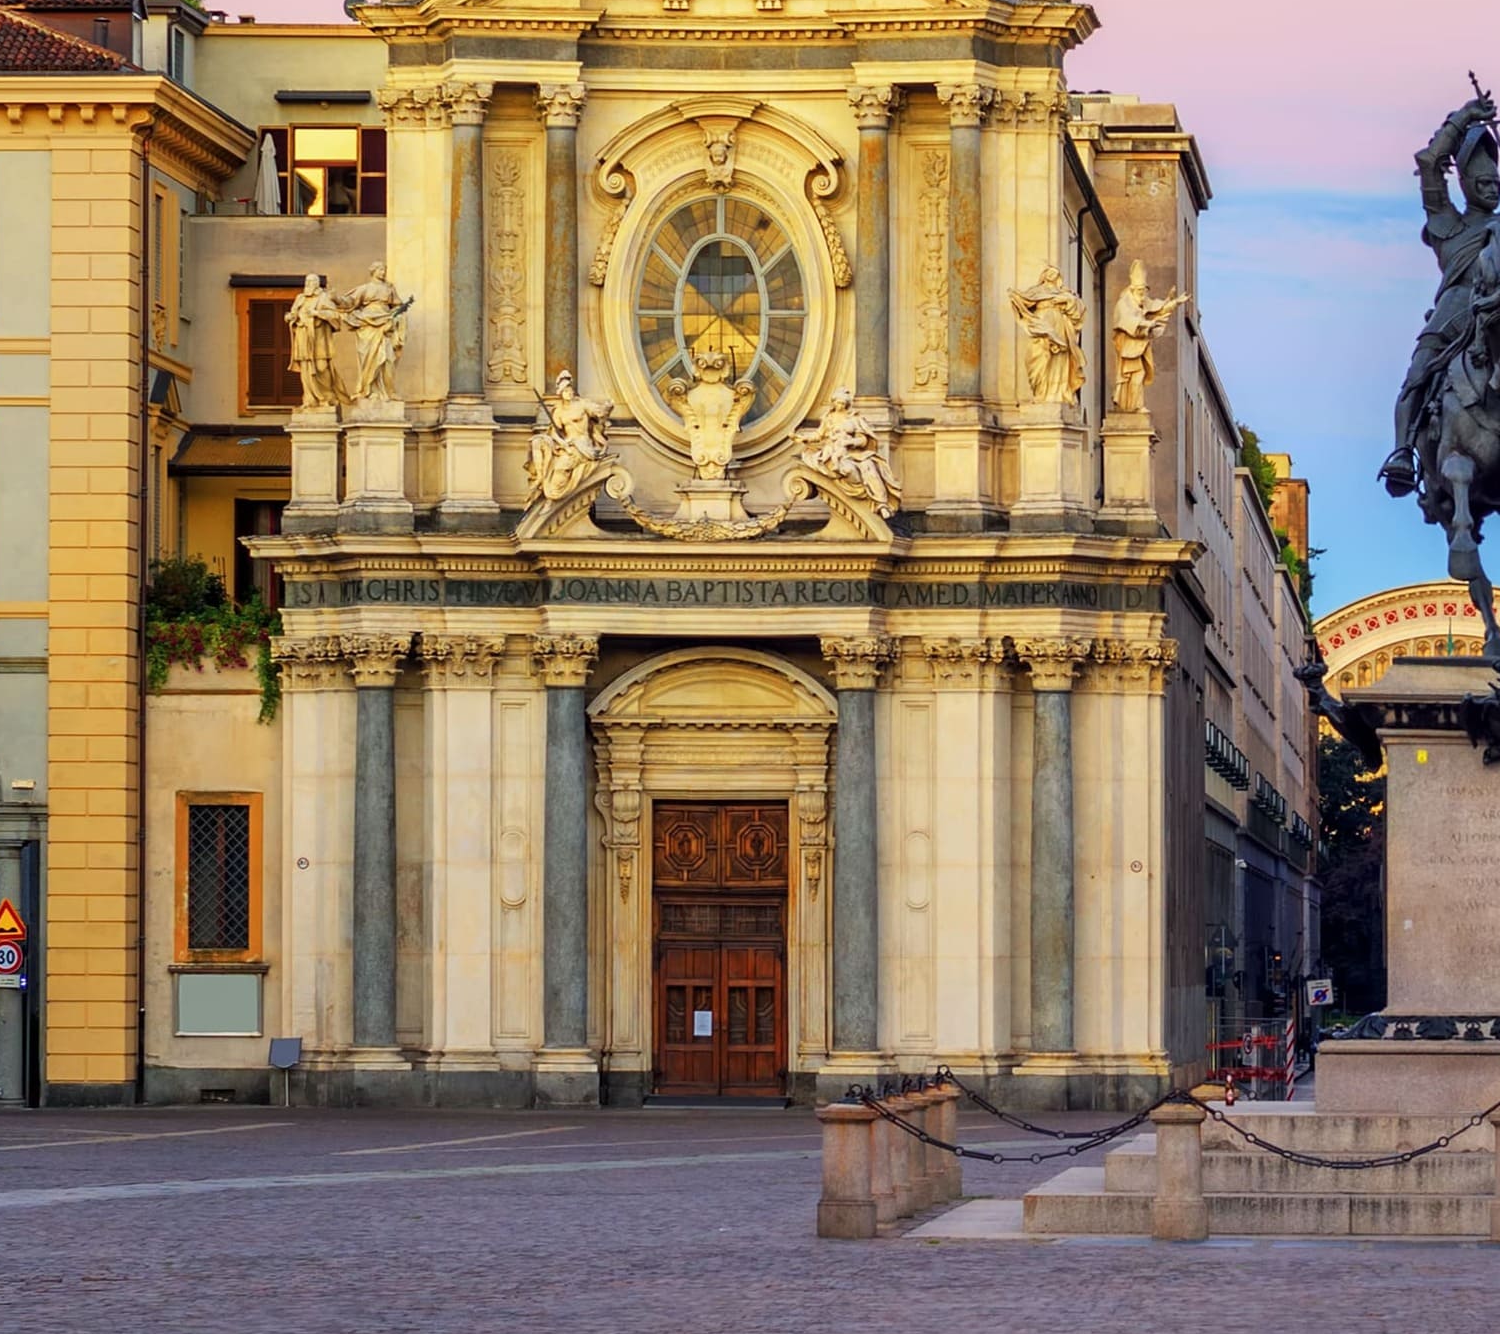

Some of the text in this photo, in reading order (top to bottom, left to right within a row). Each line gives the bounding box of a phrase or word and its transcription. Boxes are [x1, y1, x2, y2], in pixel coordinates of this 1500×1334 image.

[666, 579, 789, 603] BAPTISTA
[794, 580, 866, 603] REGIS
[982, 582, 1062, 606] MATER
